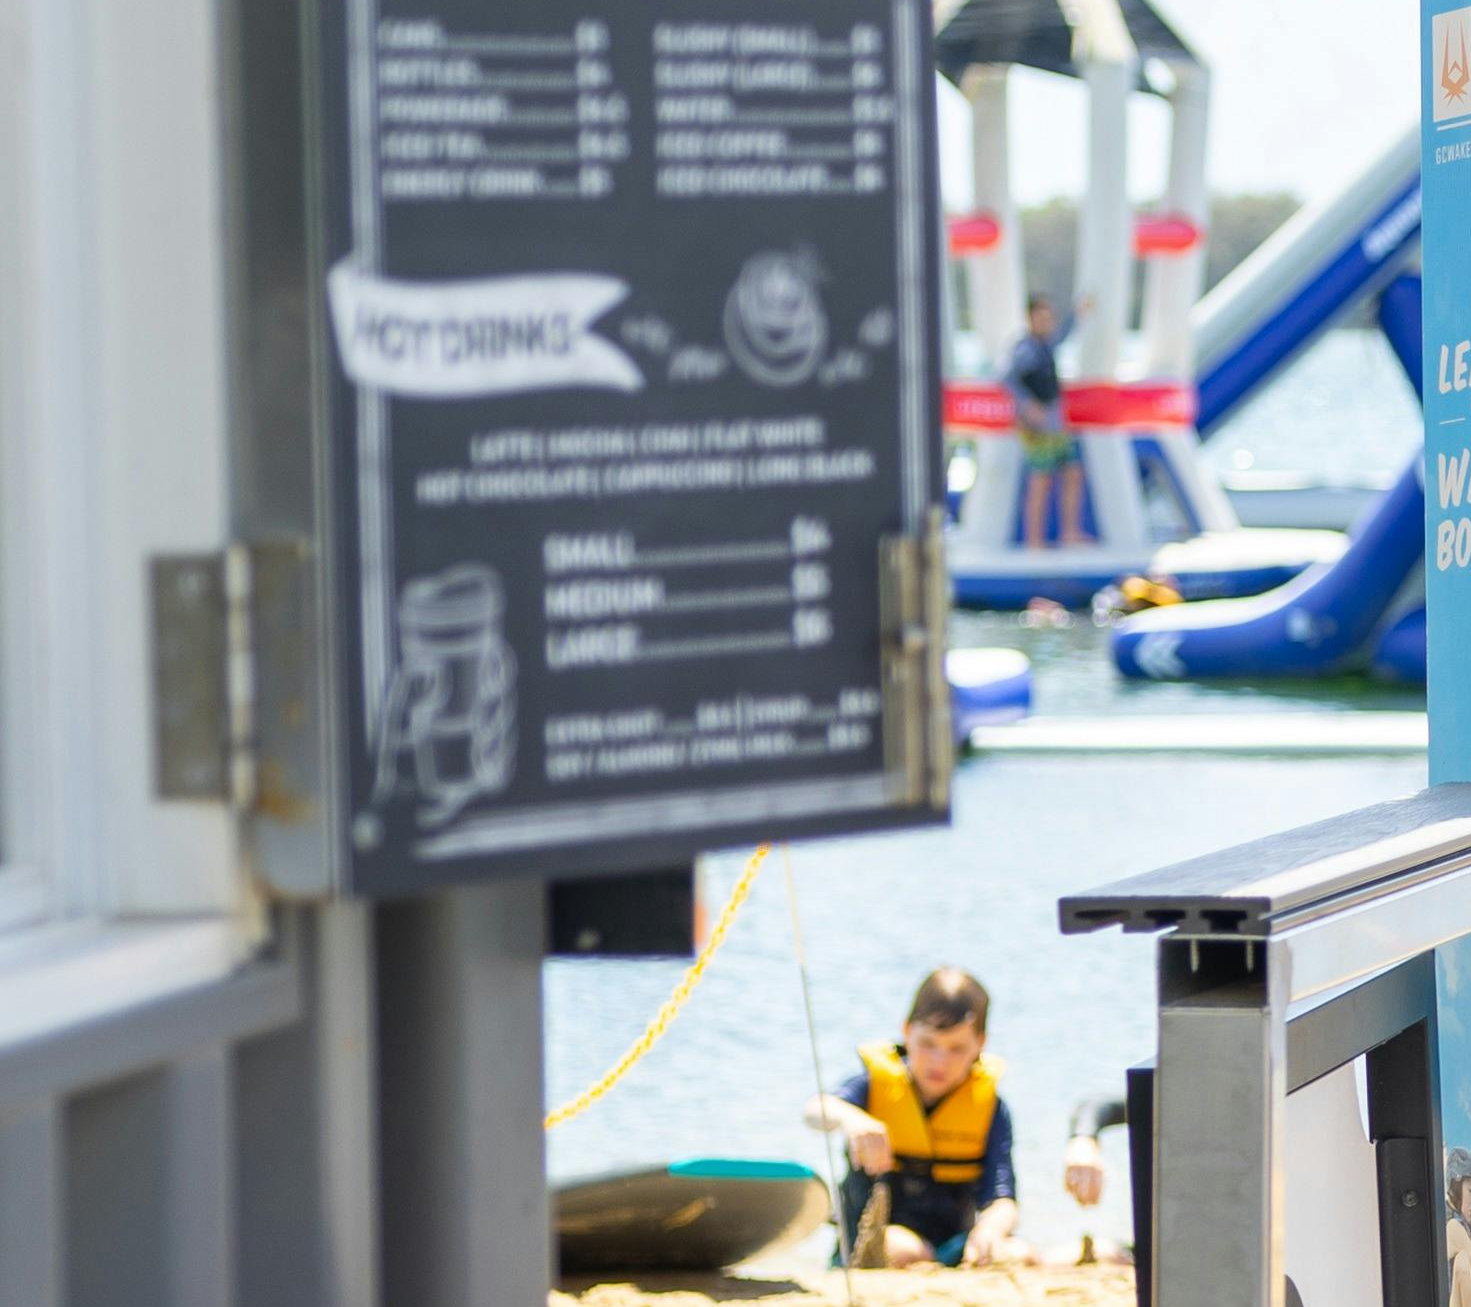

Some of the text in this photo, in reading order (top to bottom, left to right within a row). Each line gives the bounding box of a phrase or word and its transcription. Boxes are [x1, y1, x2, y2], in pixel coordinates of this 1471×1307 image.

[353, 307, 573, 362] HOT DRINKS
[543, 530, 636, 573] SMALL
[544, 577, 666, 621] MEDIUM
[546, 624, 641, 670] LARGE
